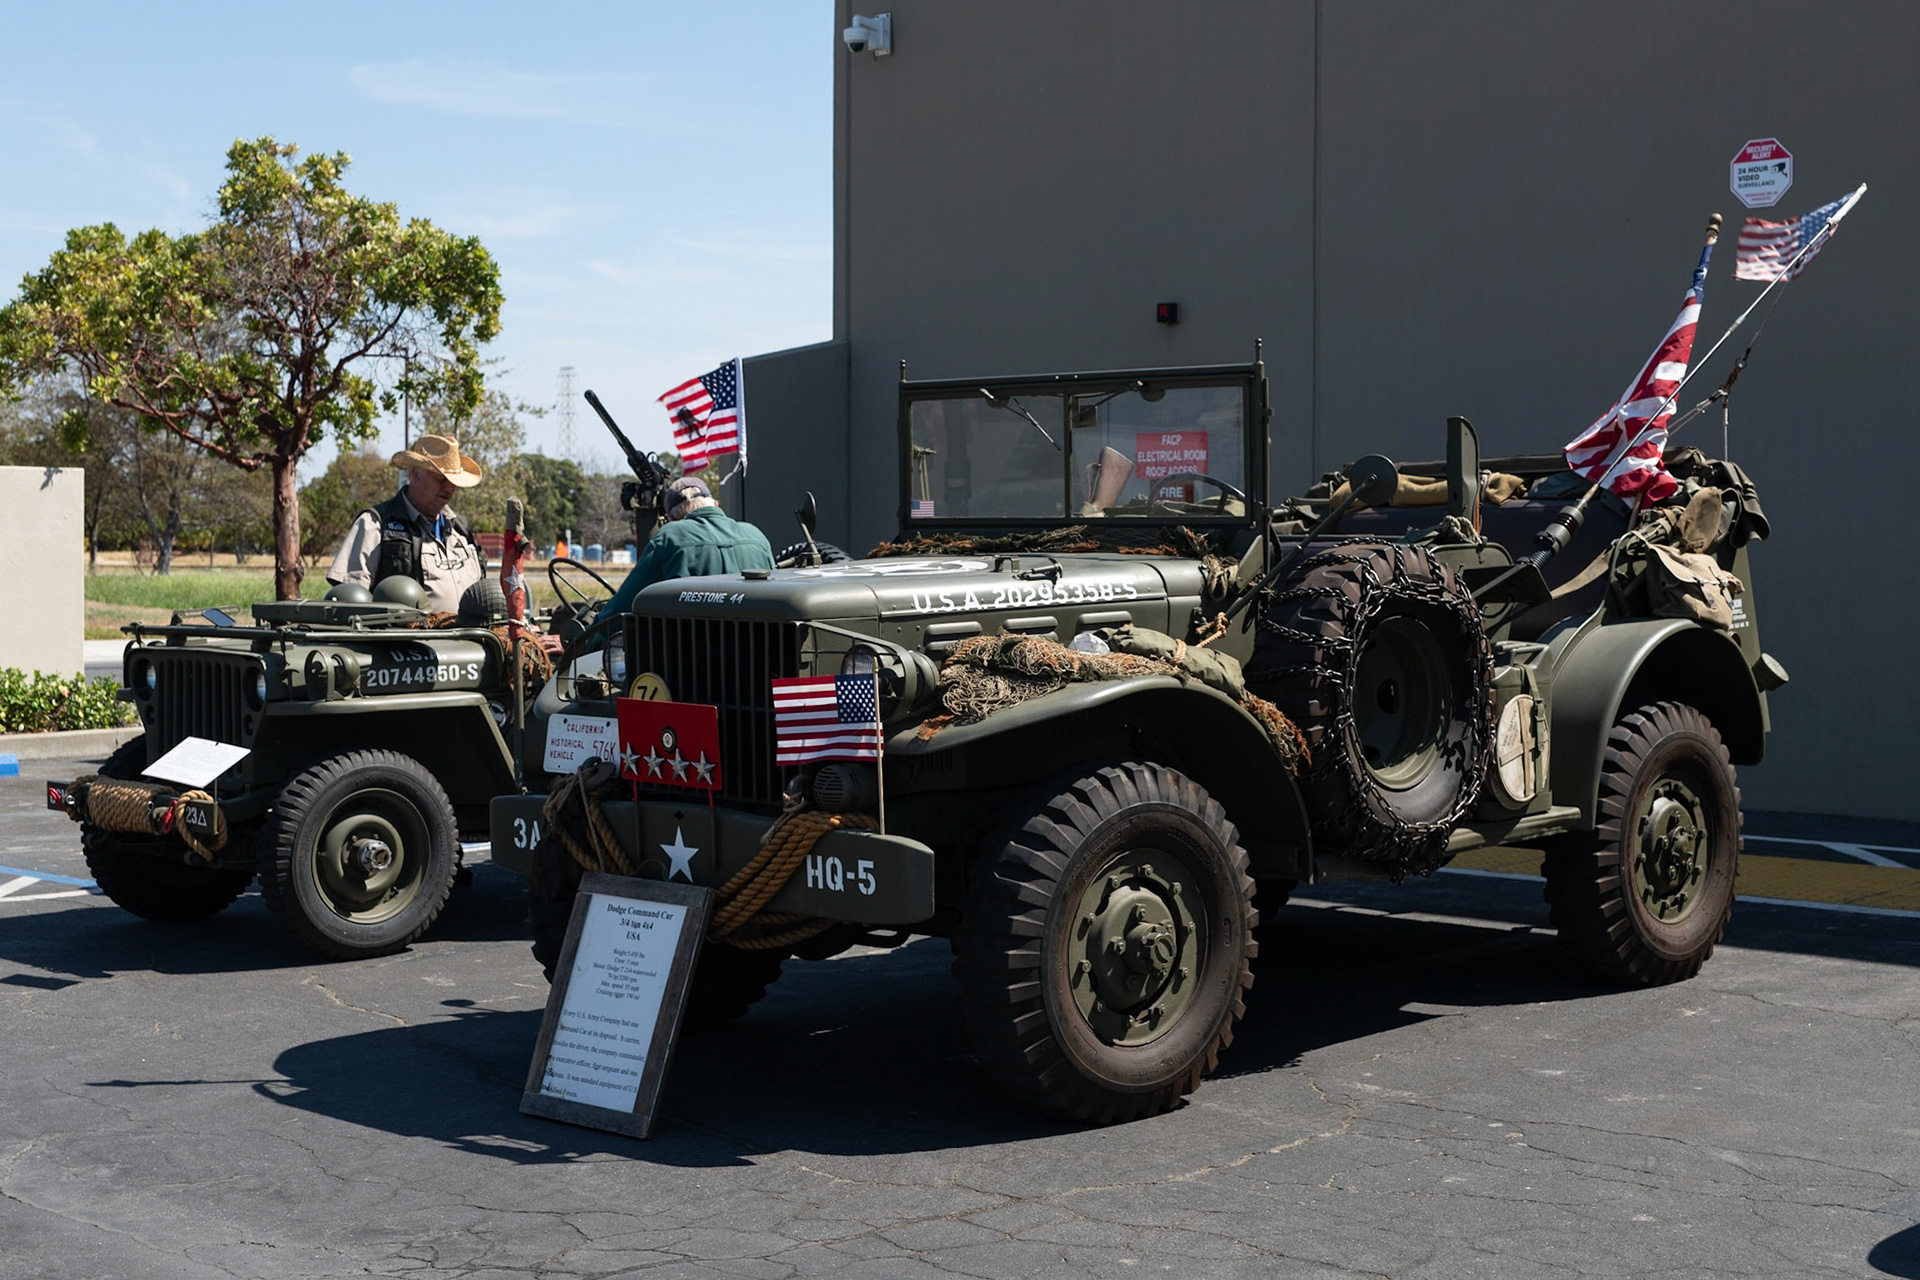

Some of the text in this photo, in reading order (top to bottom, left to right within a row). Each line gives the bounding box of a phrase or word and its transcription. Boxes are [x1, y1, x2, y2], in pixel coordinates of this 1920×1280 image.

[1746, 144, 1777, 154] SECURITY
[1751, 152, 1771, 160] ALERT
[1748, 165, 1768, 173] HOUR
[1738, 174, 1760, 182] VIDEO
[1738, 180, 1775, 189] SURVEILLANCE
[1161, 435, 1182, 446] FACP
[1137, 450, 1207, 463] ELECTRICAL ROOM
[1145, 465, 1198, 477] ROOF ACCESS
[1160, 487, 1183, 498] FIRE
[679, 591, 745, 604] PRESTONE 44
[912, 580, 1138, 613] U.S.A. 20295358-S
[366, 663, 479, 688] 20744950-S
[566, 723, 604, 734] CALIFORNIA
[550, 738, 584, 749] HISTORICAL
[549, 750, 574, 761] VEHICLE
[806, 854, 877, 896] HQ-5
[607, 903, 673, 920] Dodge Command Car
[620, 917, 630, 926] 3/4
[642, 921, 654, 929] 4x4
[627, 930, 640, 941] USA
[600, 1015, 620, 1026] Company
[598, 1048, 617, 1057] company
